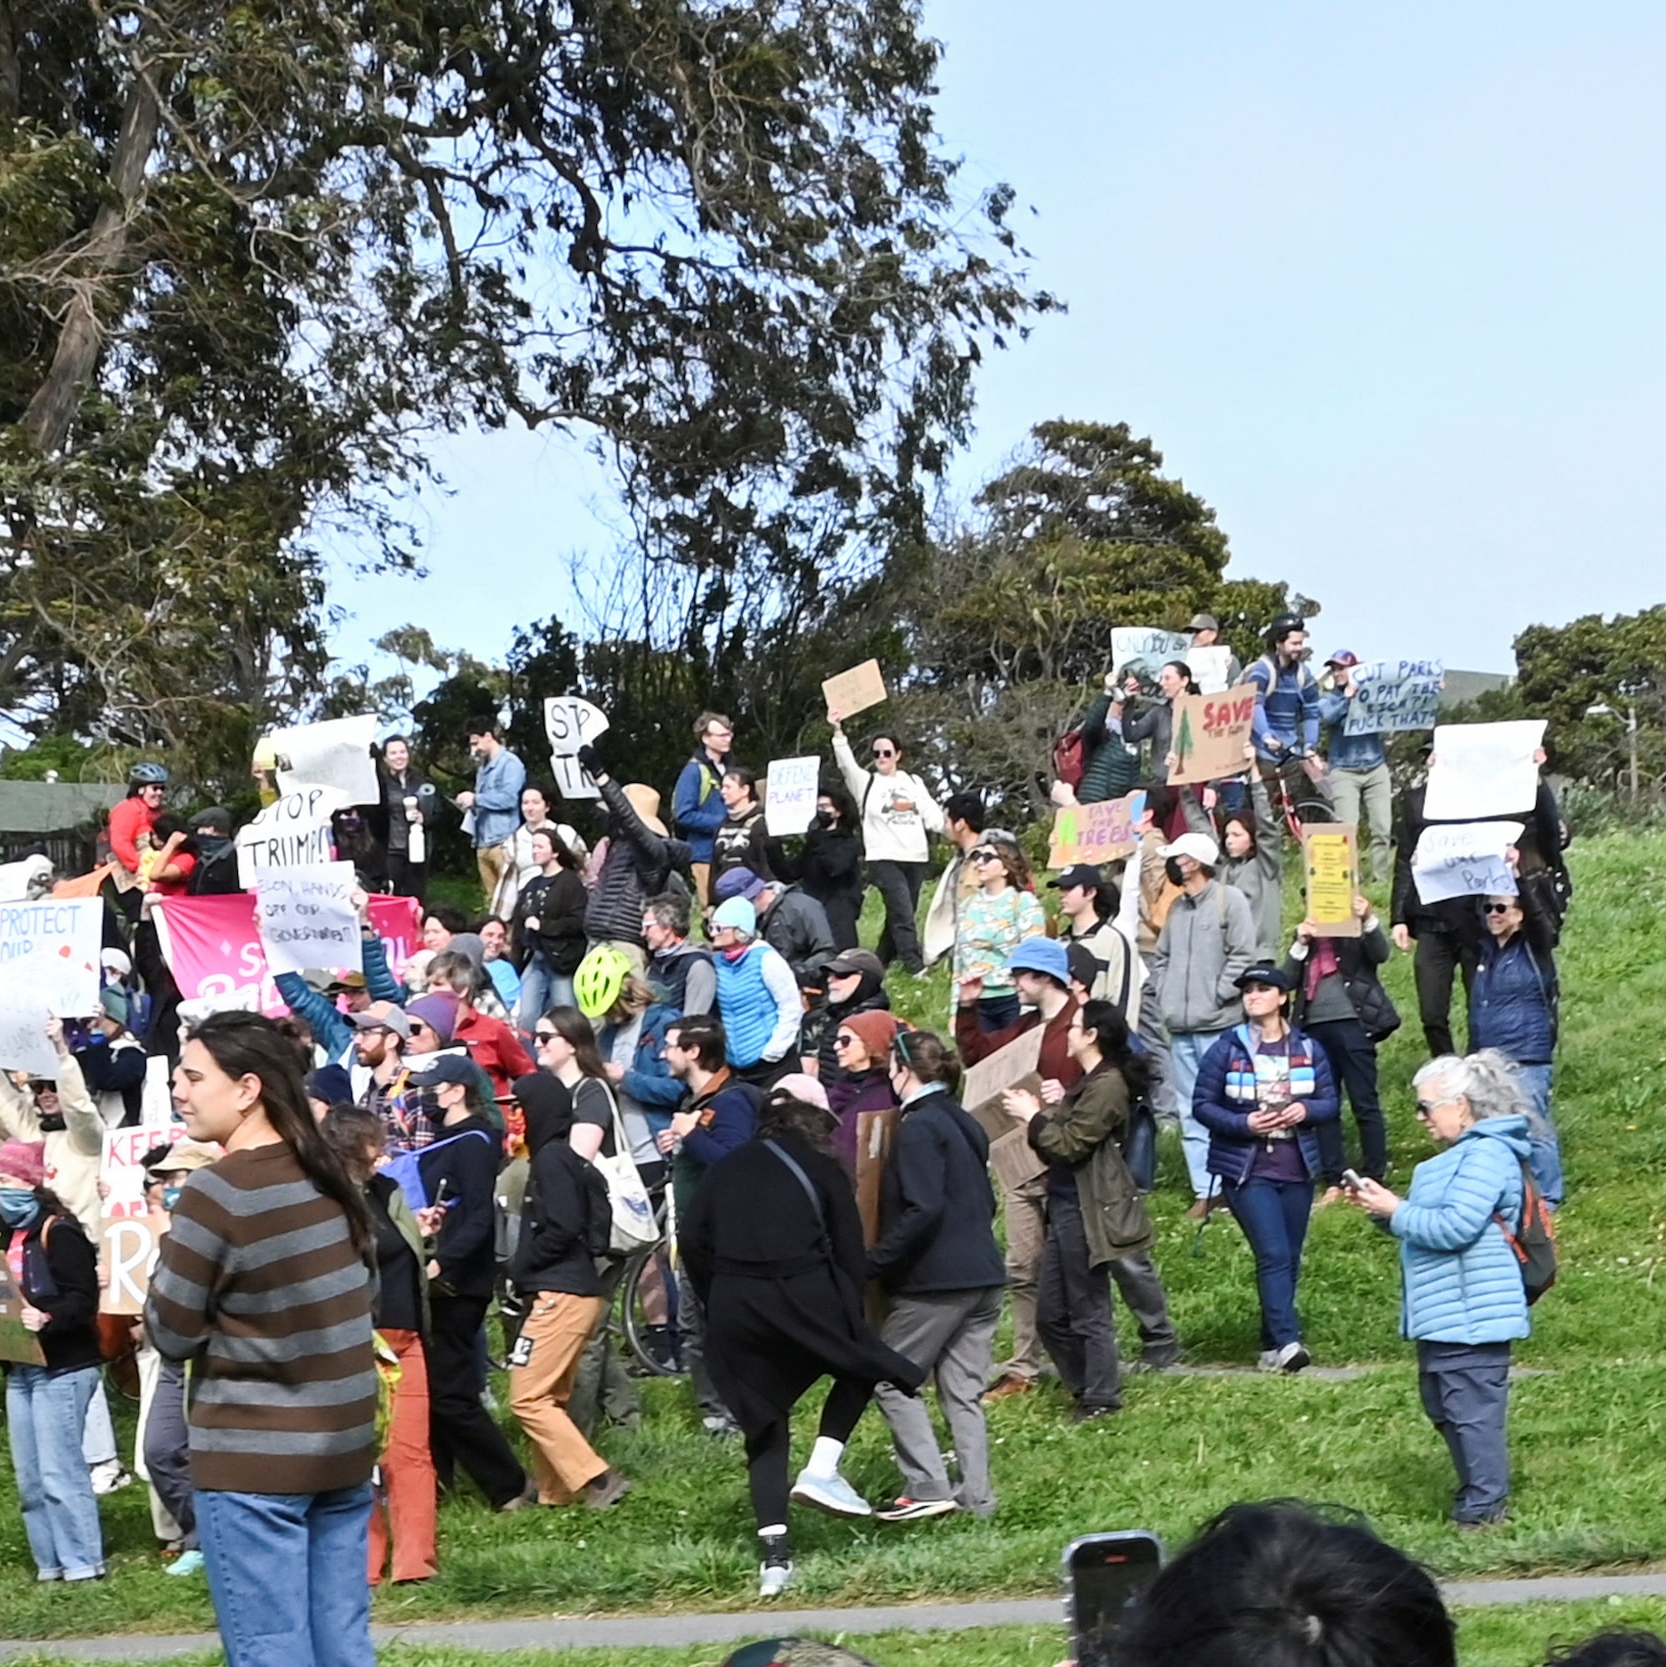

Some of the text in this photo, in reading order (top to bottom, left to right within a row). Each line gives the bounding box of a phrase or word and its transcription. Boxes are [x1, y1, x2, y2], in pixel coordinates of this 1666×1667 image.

[1353, 659, 1443, 685] CUT PARKS
[1376, 684, 1402, 702] PAY
[1203, 696, 1254, 731] SAVE
[1348, 714, 1383, 732] FUCK
[770, 763, 814, 786] DEFEND
[768, 787, 814, 804] PLANET
[1077, 822, 1132, 846] TREES
[1424, 831, 1472, 853] Save
[0, 905, 82, 937] PROTECT
